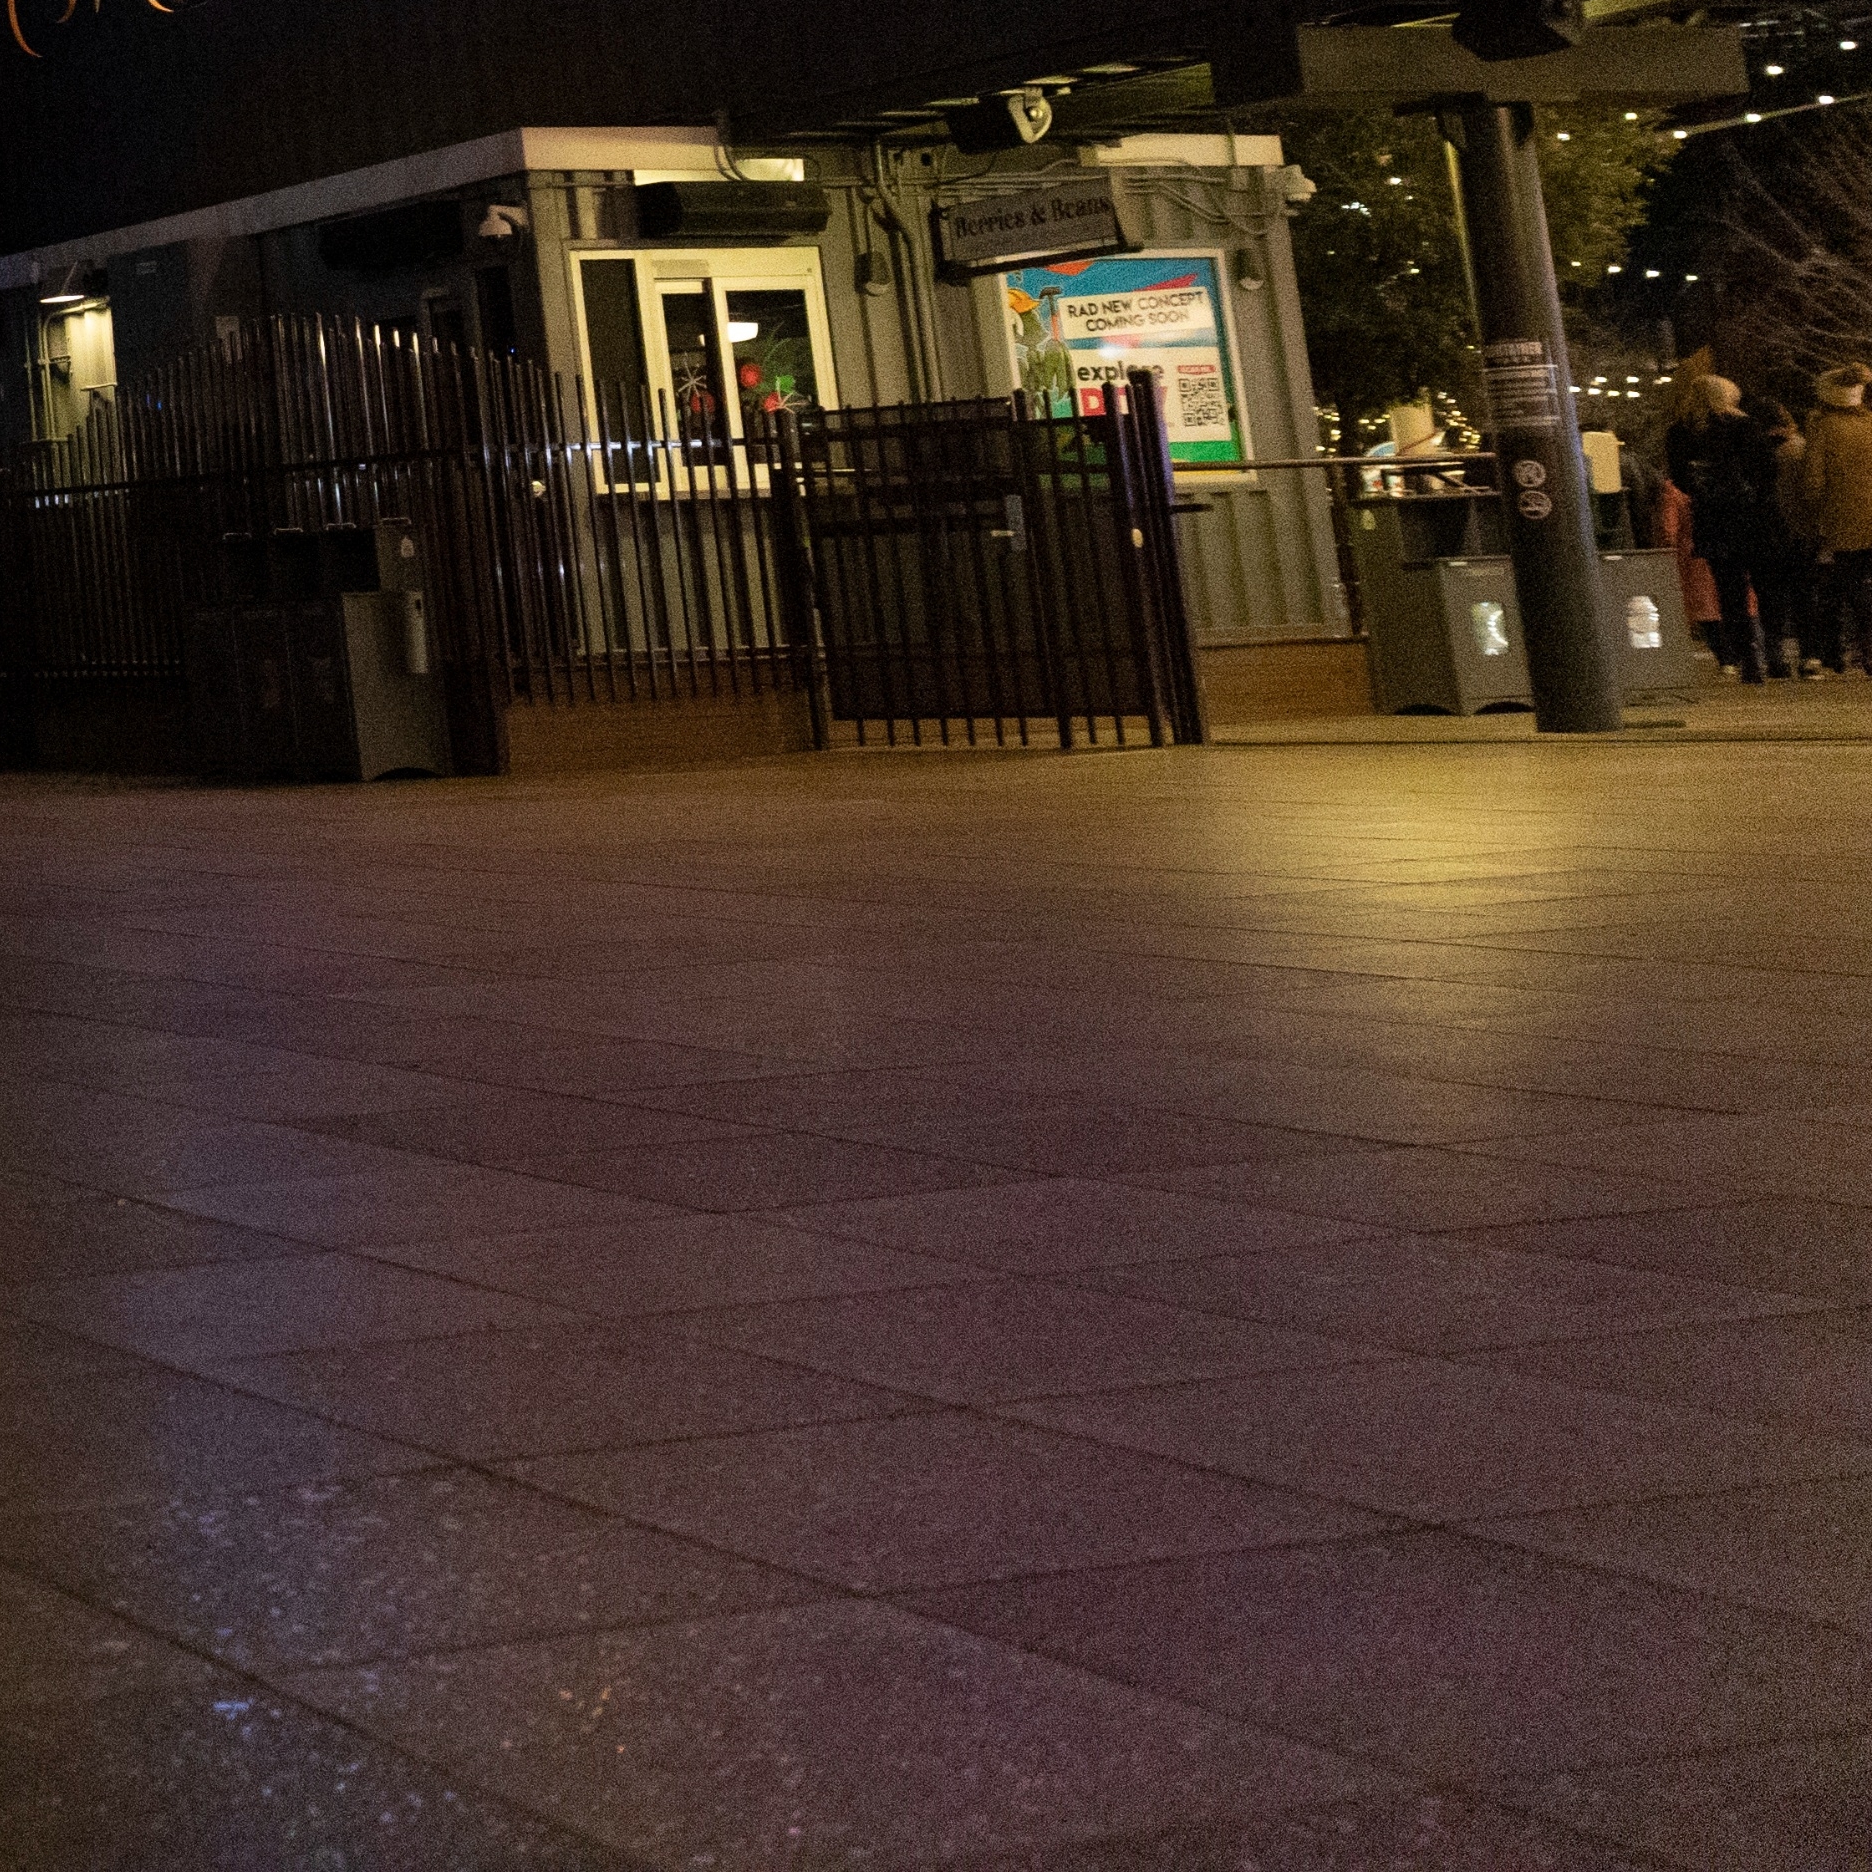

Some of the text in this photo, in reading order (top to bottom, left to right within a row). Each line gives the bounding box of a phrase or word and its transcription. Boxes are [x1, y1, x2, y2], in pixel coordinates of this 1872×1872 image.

[954, 197, 1111, 239] Berries & Beans
[1067, 290, 1204, 318] RAD NEW CONCEPT
[1085, 310, 1190, 332] COMING SOON
